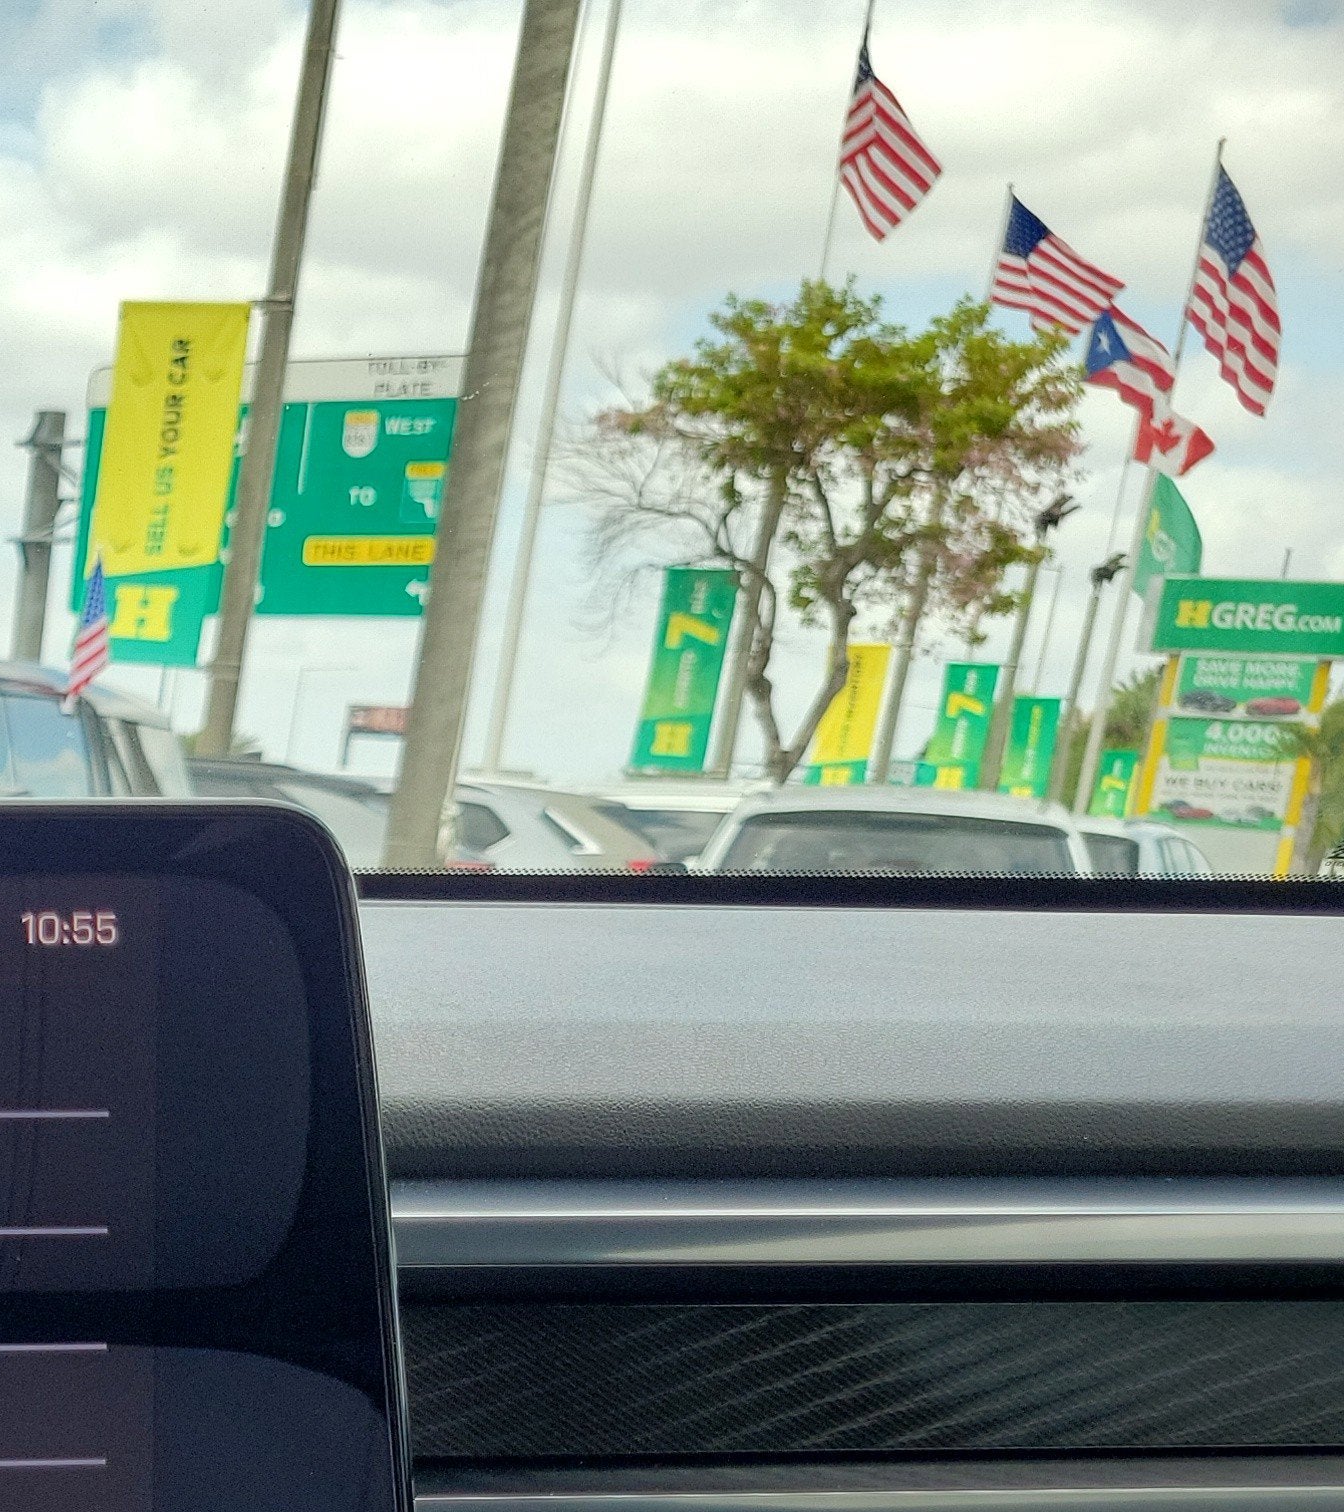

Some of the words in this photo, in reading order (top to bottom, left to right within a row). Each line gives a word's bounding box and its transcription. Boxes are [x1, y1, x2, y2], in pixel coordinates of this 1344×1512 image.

[167, 337, 193, 386] CAR
[159, 393, 186, 459] YOUR
[349, 485, 377, 507] TO
[314, 543, 357, 560] THIS
[369, 542, 425, 562] LANE
[665, 612, 720, 650] 7
[945, 691, 985, 719] 7
[20, 911, 118, 947] 10:55
